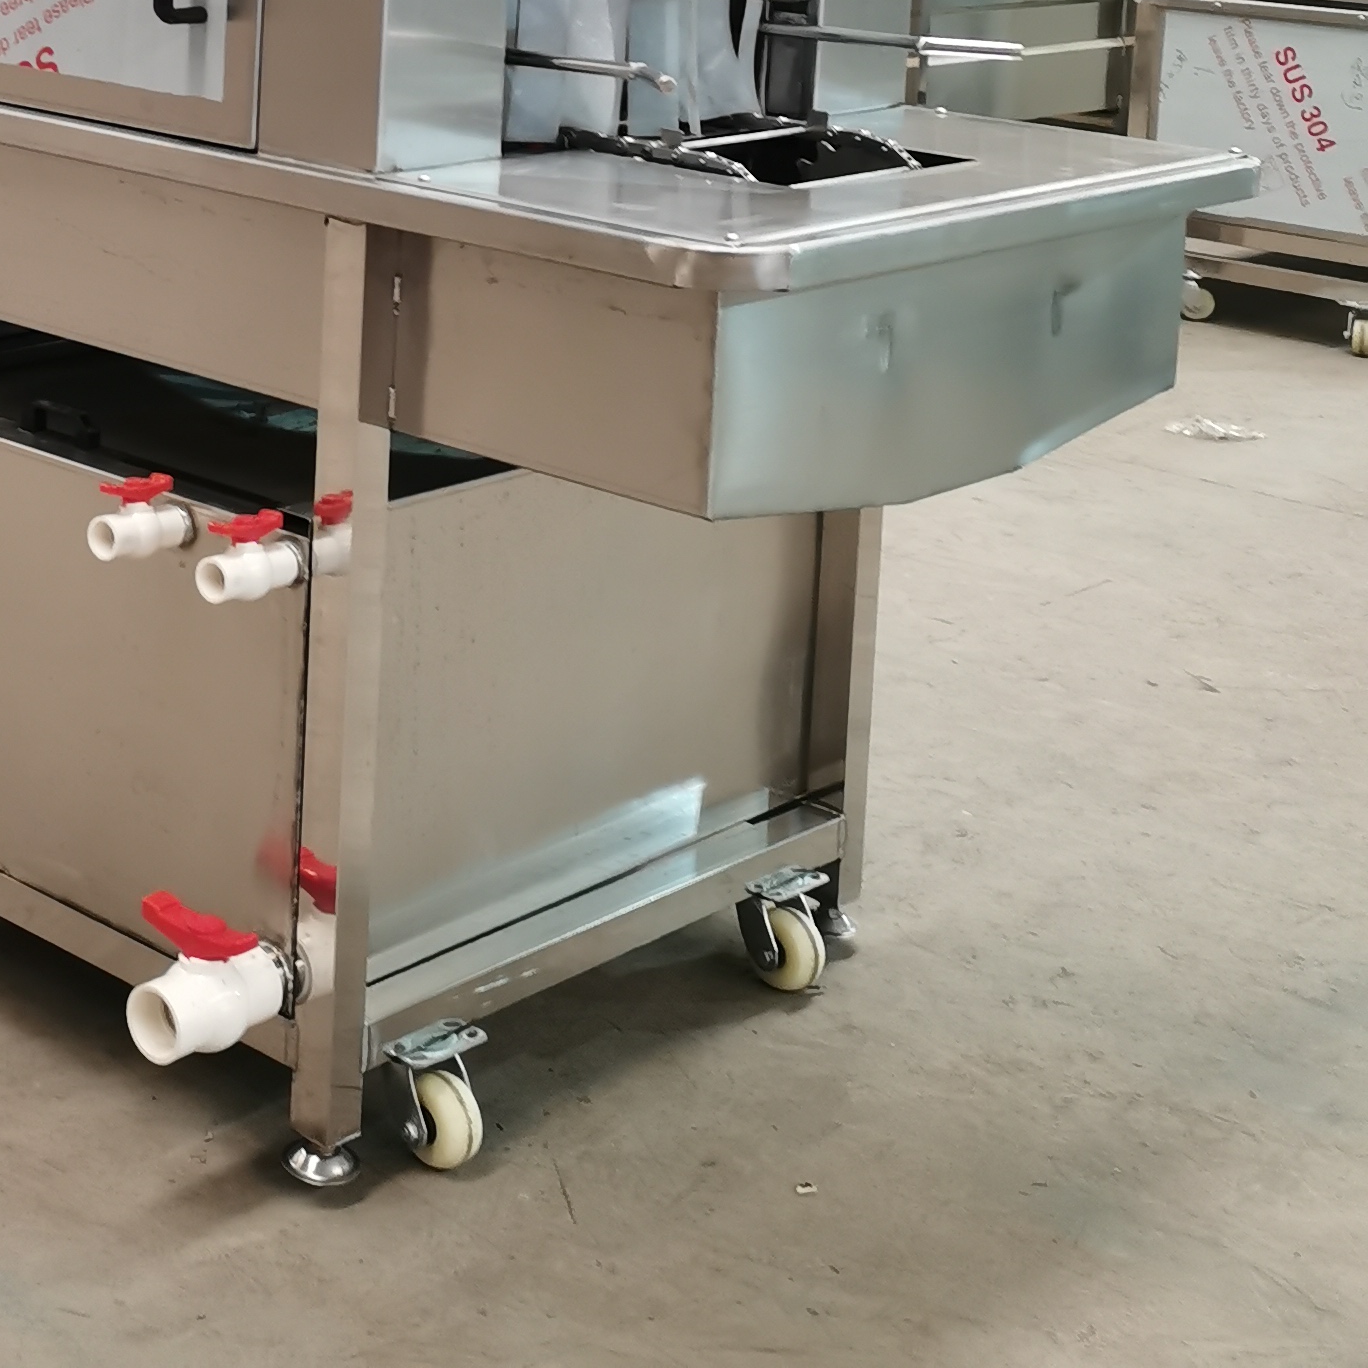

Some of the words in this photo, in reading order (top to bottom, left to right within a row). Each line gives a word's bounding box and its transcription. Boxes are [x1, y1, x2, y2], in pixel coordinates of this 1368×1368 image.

[12, 17, 42, 45] tear
[1236, 52, 1245, 65] in
[1240, 67, 1260, 99] thirty
[1275, 46, 1313, 104] SUS
[1300, 106, 1337, 152] 304
[1233, 90, 1256, 131] factory
[1257, 102, 1277, 133] days
[1270, 86, 1290, 121] down
[1285, 117, 1298, 140] the
[1272, 135, 1286, 150] of
[1278, 152, 1311, 208] products
